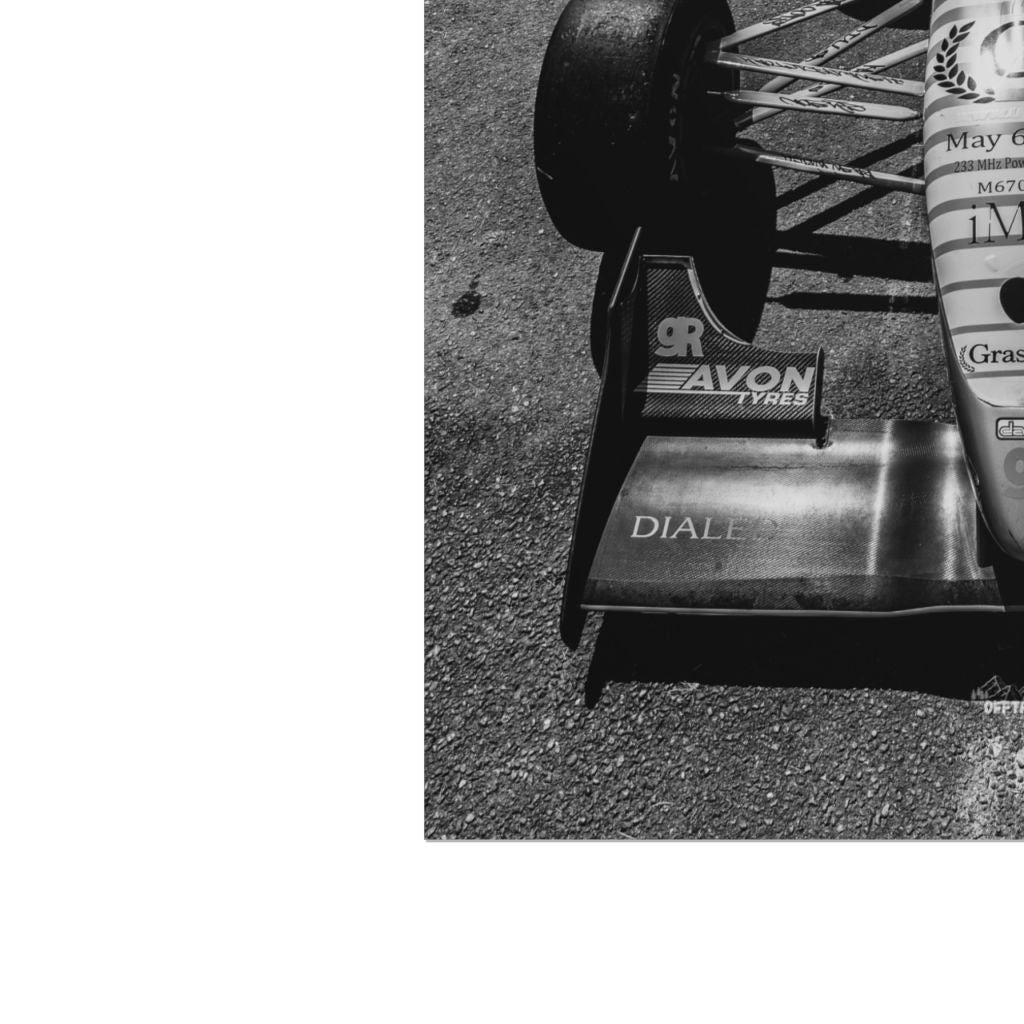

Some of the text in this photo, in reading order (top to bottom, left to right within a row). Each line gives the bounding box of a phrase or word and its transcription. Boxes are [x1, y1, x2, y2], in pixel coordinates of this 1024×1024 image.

[946, 131, 1002, 153] May
[953, 159, 974, 173] 233
[977, 158, 1002, 171] MHz
[681, 364, 816, 393] AVON
[737, 392, 809, 406] TYRES
